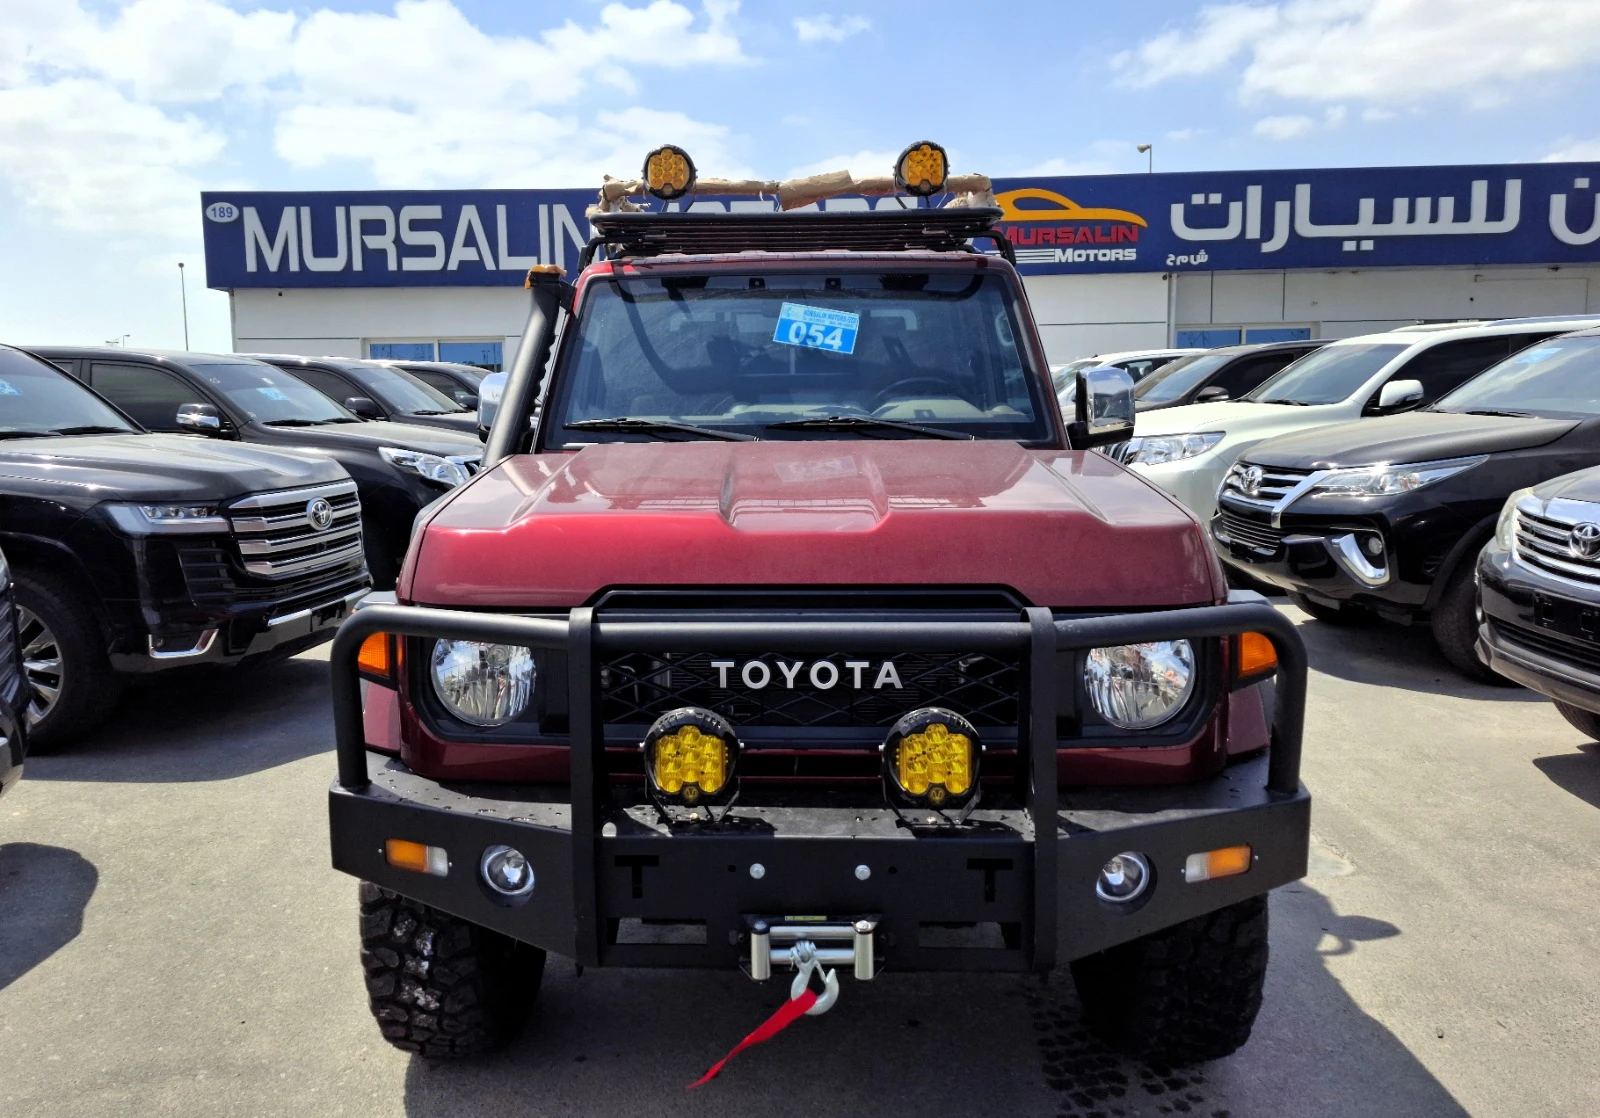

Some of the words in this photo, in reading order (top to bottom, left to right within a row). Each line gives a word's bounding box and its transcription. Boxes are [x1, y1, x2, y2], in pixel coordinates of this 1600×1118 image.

[211, 206, 234, 219] 189
[1170, 178, 1522, 254] للسيارات
[243, 203, 600, 273] MURSALIN
[992, 225, 1138, 246] MURSALIN
[1054, 247, 1137, 264] MOTORS
[788, 321, 843, 349] 054
[710, 660, 903, 690] TOYOTA
